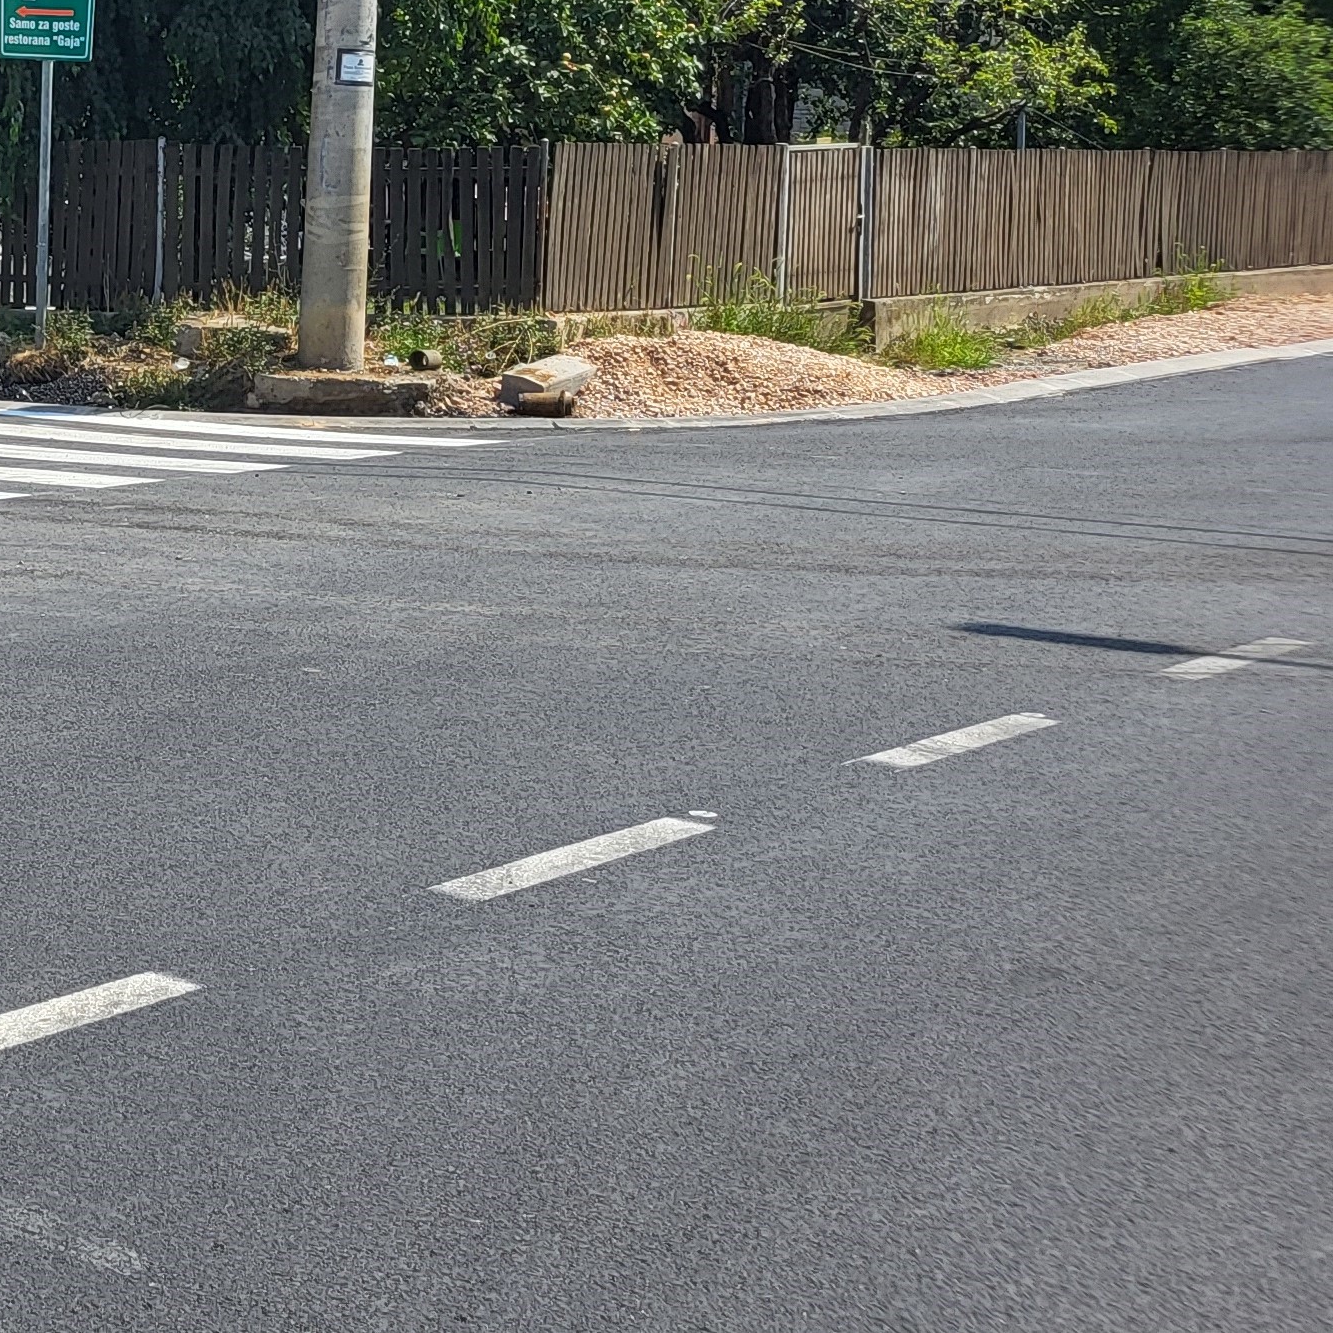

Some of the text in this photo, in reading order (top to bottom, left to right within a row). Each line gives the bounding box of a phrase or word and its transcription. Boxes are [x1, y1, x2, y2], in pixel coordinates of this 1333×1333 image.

[9, 17, 80, 32] Samo za goste
[4, 34, 51, 46] restorana
